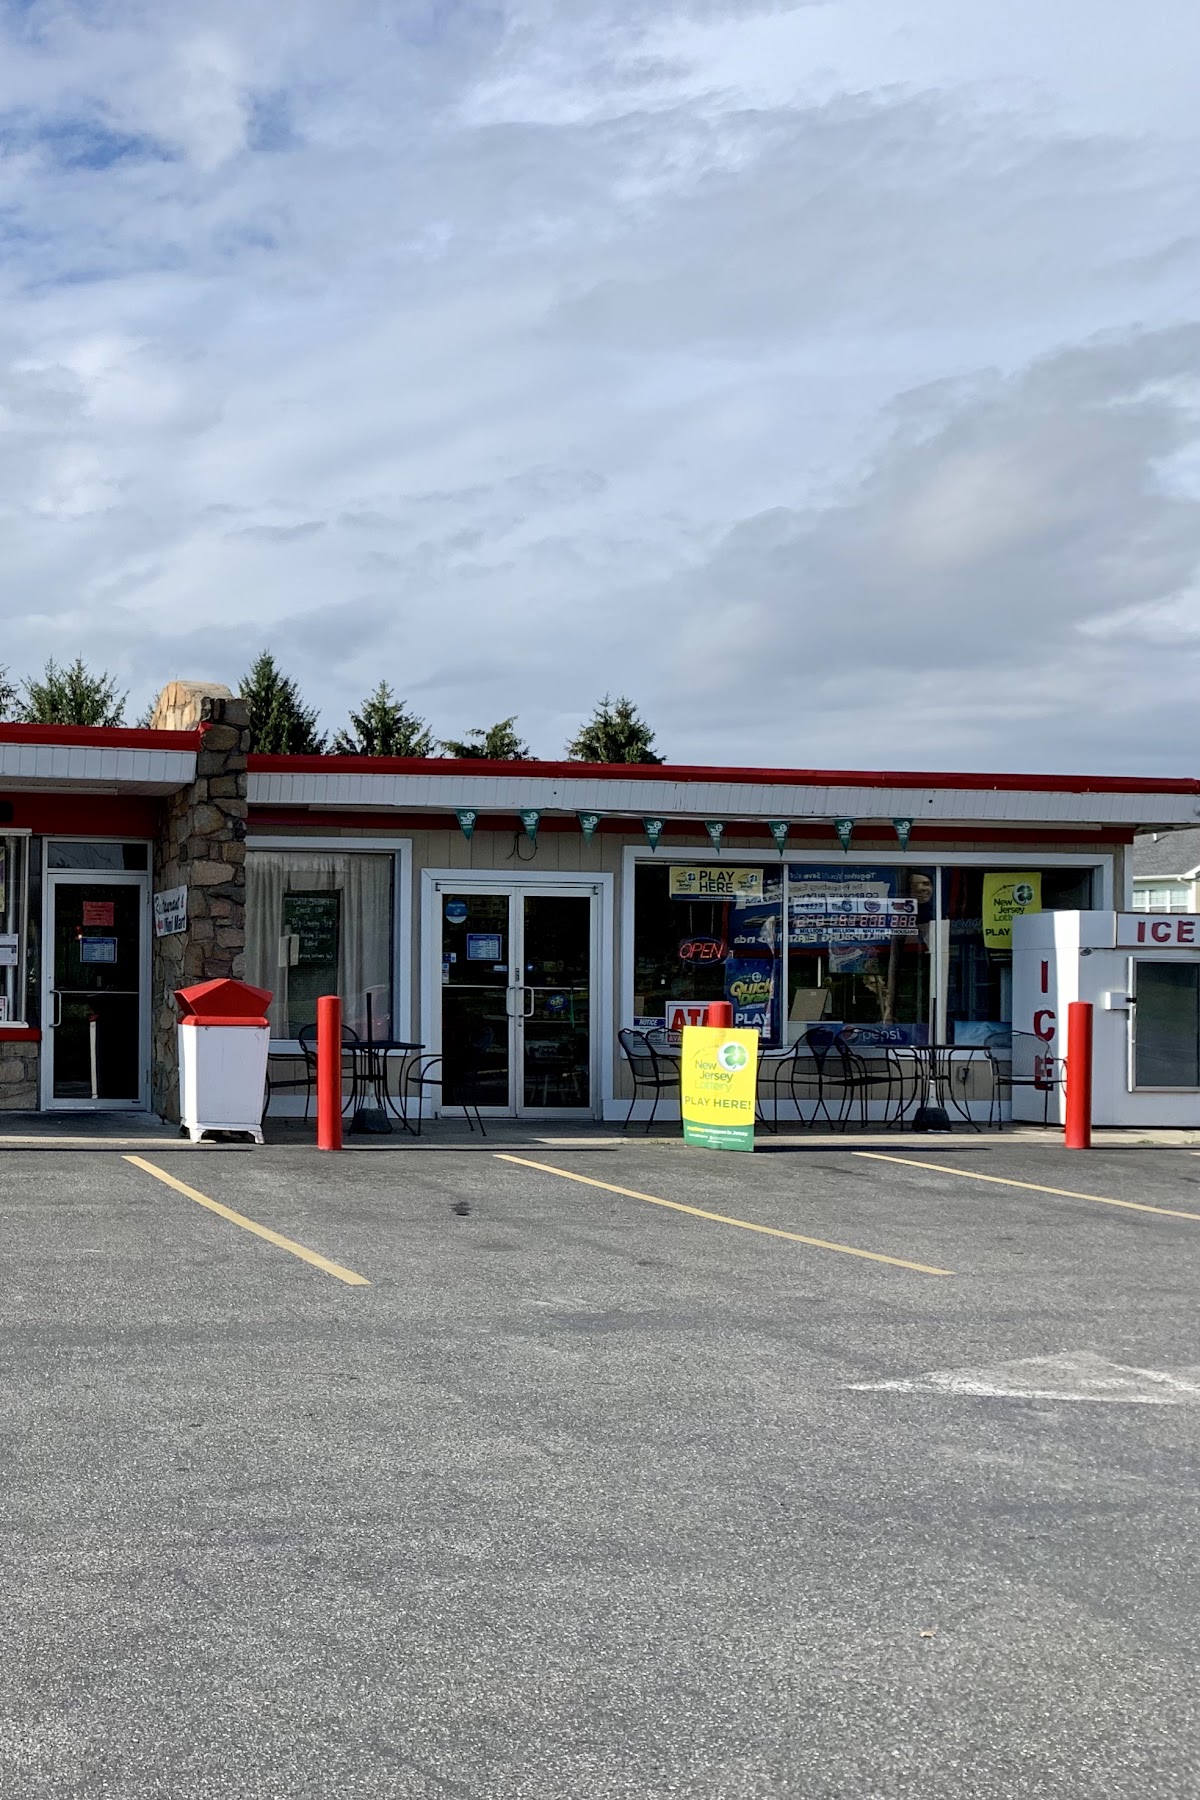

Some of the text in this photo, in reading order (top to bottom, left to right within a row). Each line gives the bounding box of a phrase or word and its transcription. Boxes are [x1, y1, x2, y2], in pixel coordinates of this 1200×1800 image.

[699, 870, 735, 881] PLAY
[699, 882, 734, 893] HERE
[993, 898, 1013, 906] New
[998, 906, 1025, 915] Jersey
[994, 914, 1012, 922] Lott
[986, 928, 1010, 936] PLAY
[1137, 921, 1196, 943] ICE
[679, 943, 723, 960] OPEN
[735, 1013, 771, 1024] PLAY
[862, 1028, 901, 1042] pepsi
[695, 1060, 718, 1070] New
[699, 1070, 734, 1083] Jersey
[695, 1080, 733, 1093] Lottery
[684, 1096, 752, 1110] PLAY HERE!
